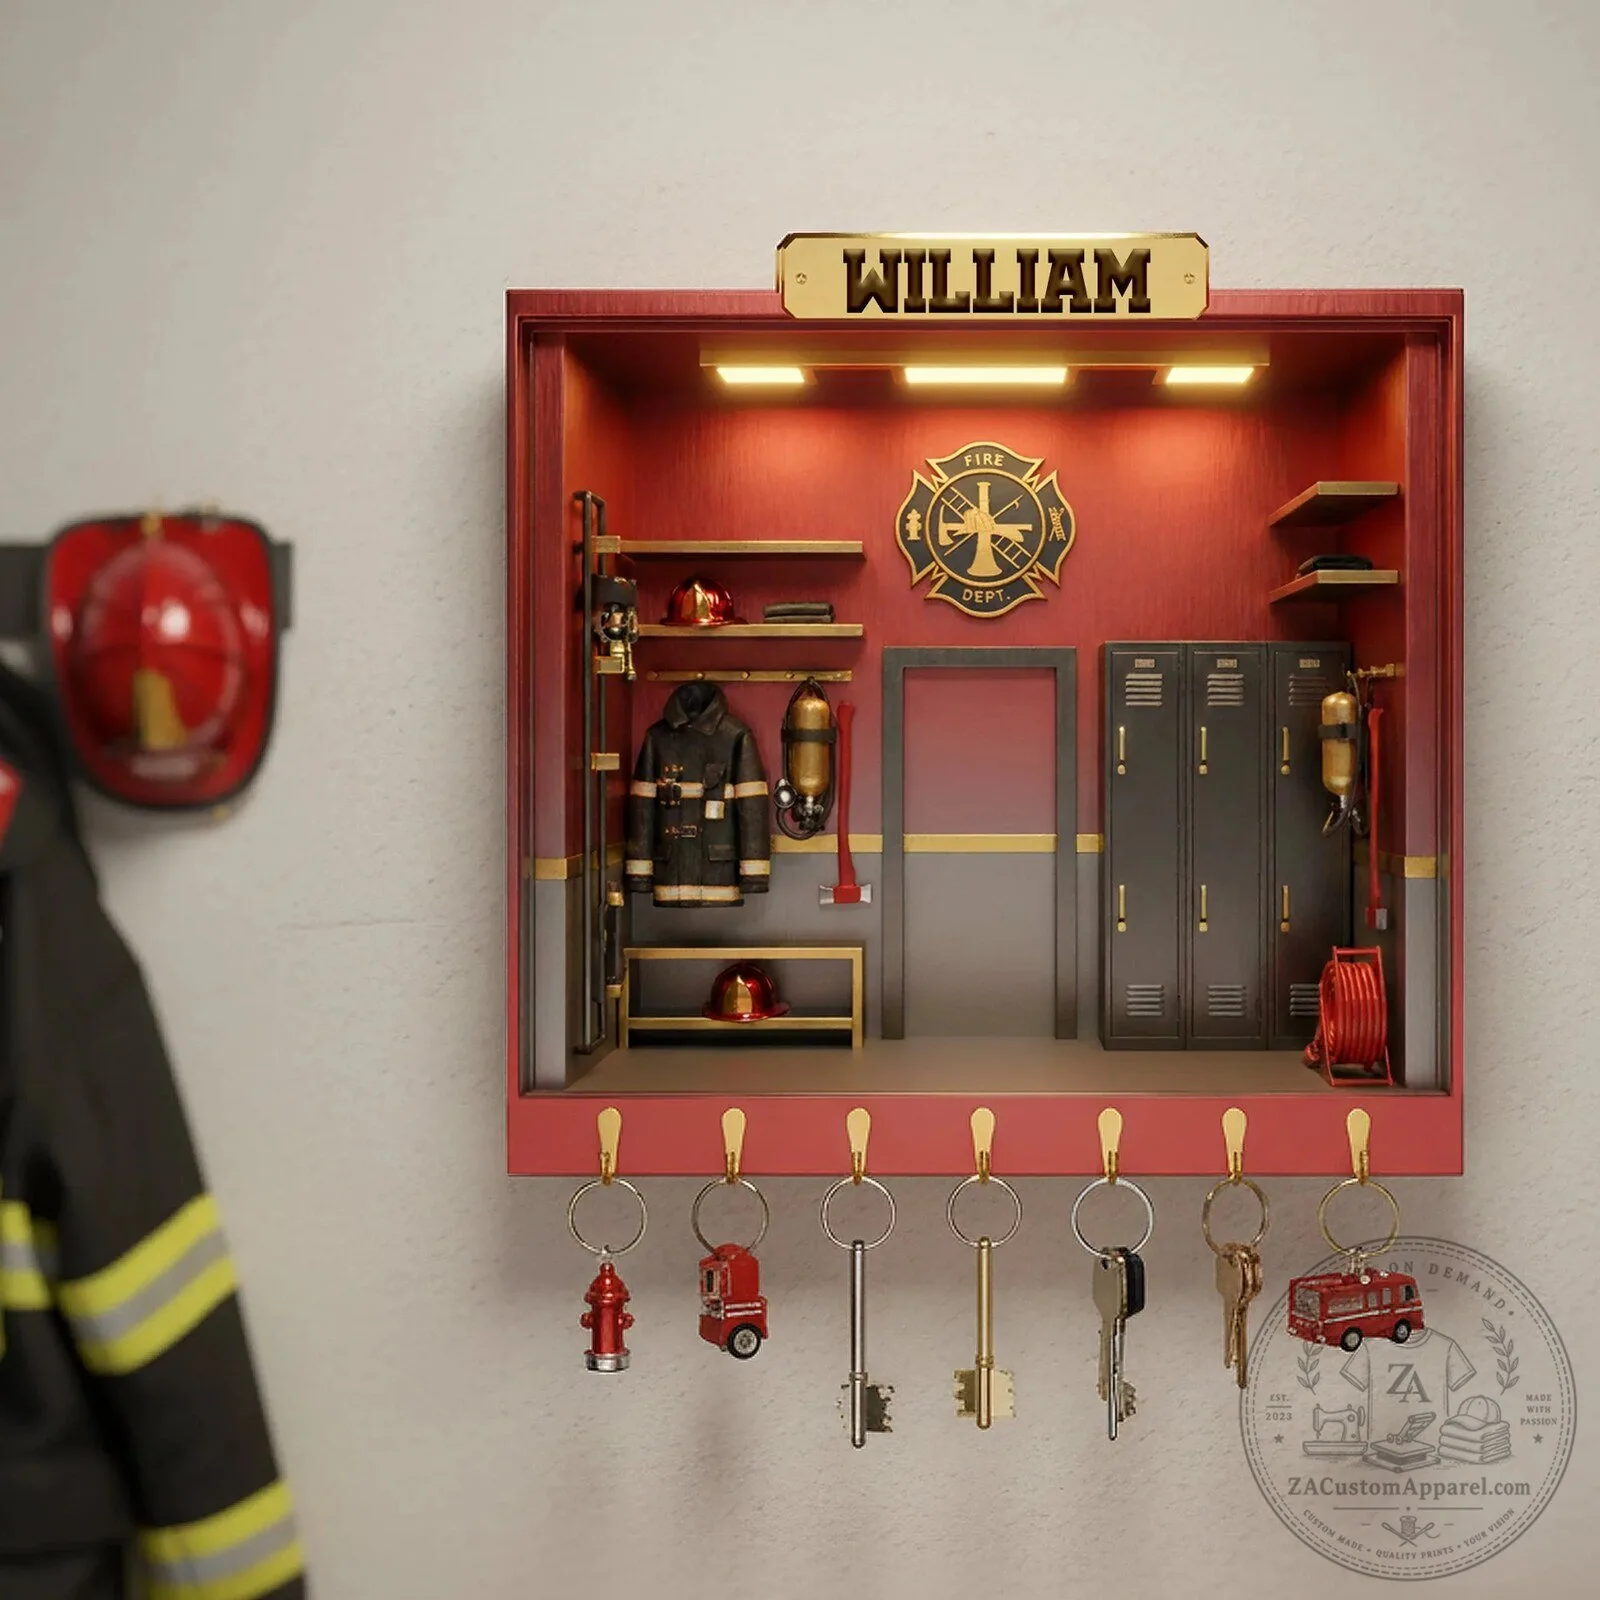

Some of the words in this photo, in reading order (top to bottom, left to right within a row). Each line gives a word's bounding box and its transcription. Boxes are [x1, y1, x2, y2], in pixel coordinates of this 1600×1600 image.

[843, 248, 1151, 313] WILLIAM
[964, 453, 1005, 467] FIRE
[962, 588, 1011, 603] DEPT.
